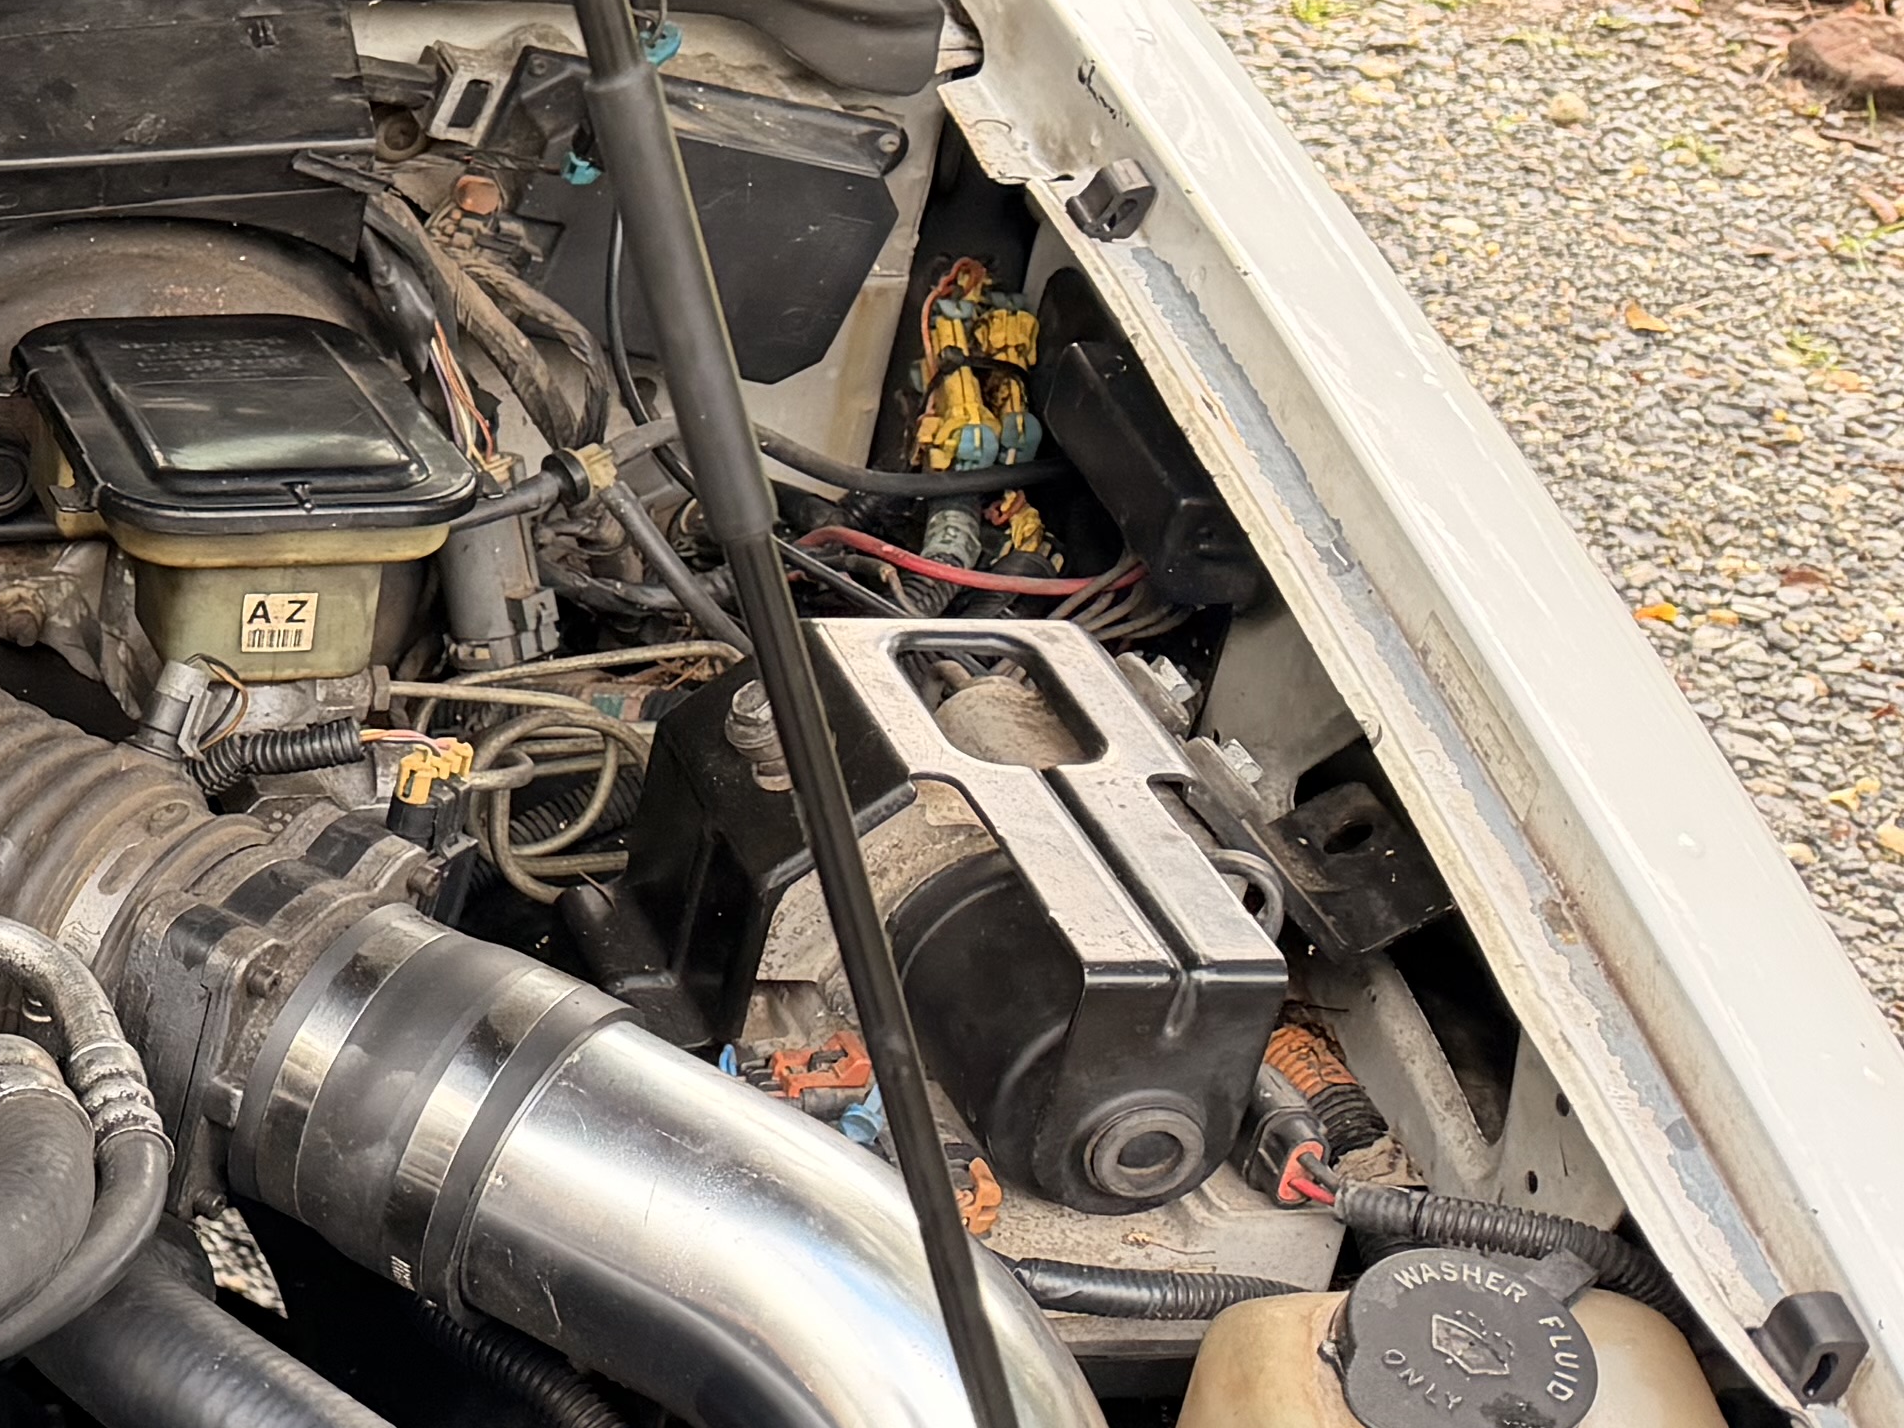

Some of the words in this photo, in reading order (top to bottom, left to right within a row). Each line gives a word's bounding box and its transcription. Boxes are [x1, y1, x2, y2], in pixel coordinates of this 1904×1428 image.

[247, 601, 271, 623] A
[285, 601, 308, 623] Z
[1394, 1263, 1527, 1303] WASHER
[1539, 1315, 1580, 1402] FLUID
[1381, 1349, 1462, 1409] ONLY
